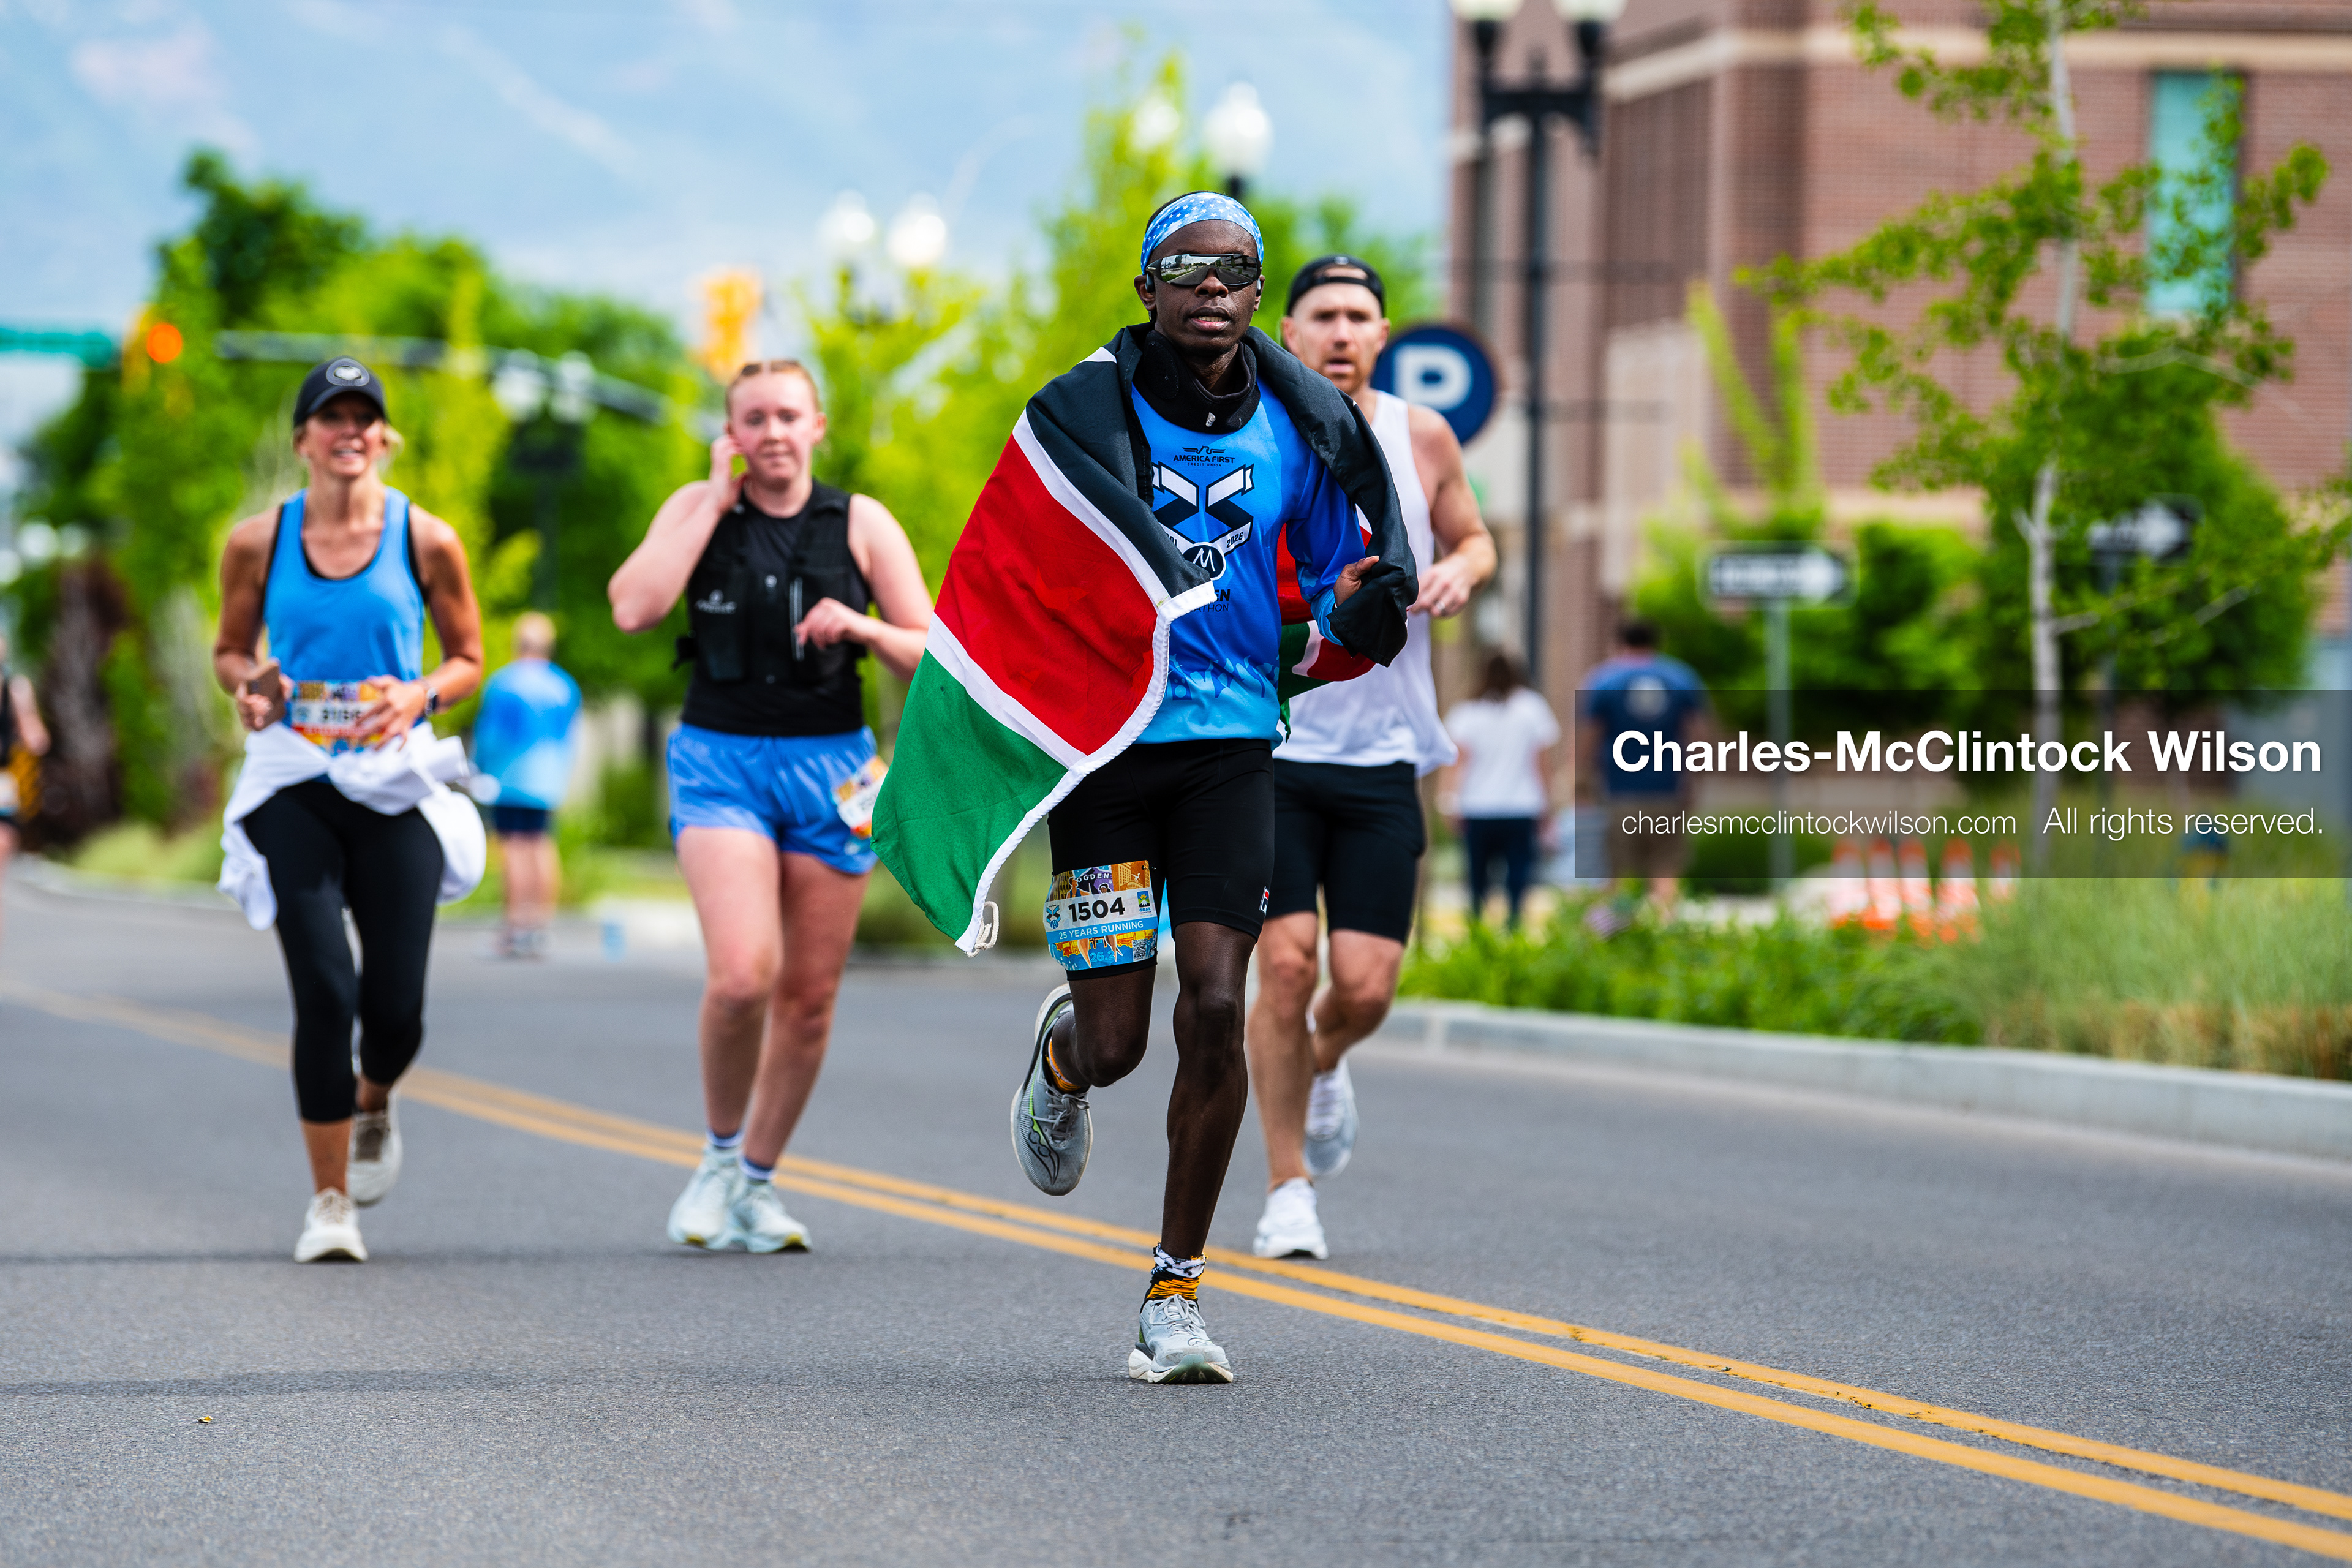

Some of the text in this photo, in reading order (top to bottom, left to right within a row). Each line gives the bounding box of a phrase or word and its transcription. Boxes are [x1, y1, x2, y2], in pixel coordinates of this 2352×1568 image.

[1392, 342, 1472, 410] P
[1226, 532, 1244, 549] 2026
[1076, 873, 1110, 883] OGDEN
[1068, 897, 1126, 922] 1504
[1058, 921, 1144, 940] 25 YEARS RUNNING
[1090, 950, 1115, 963] 26.2
